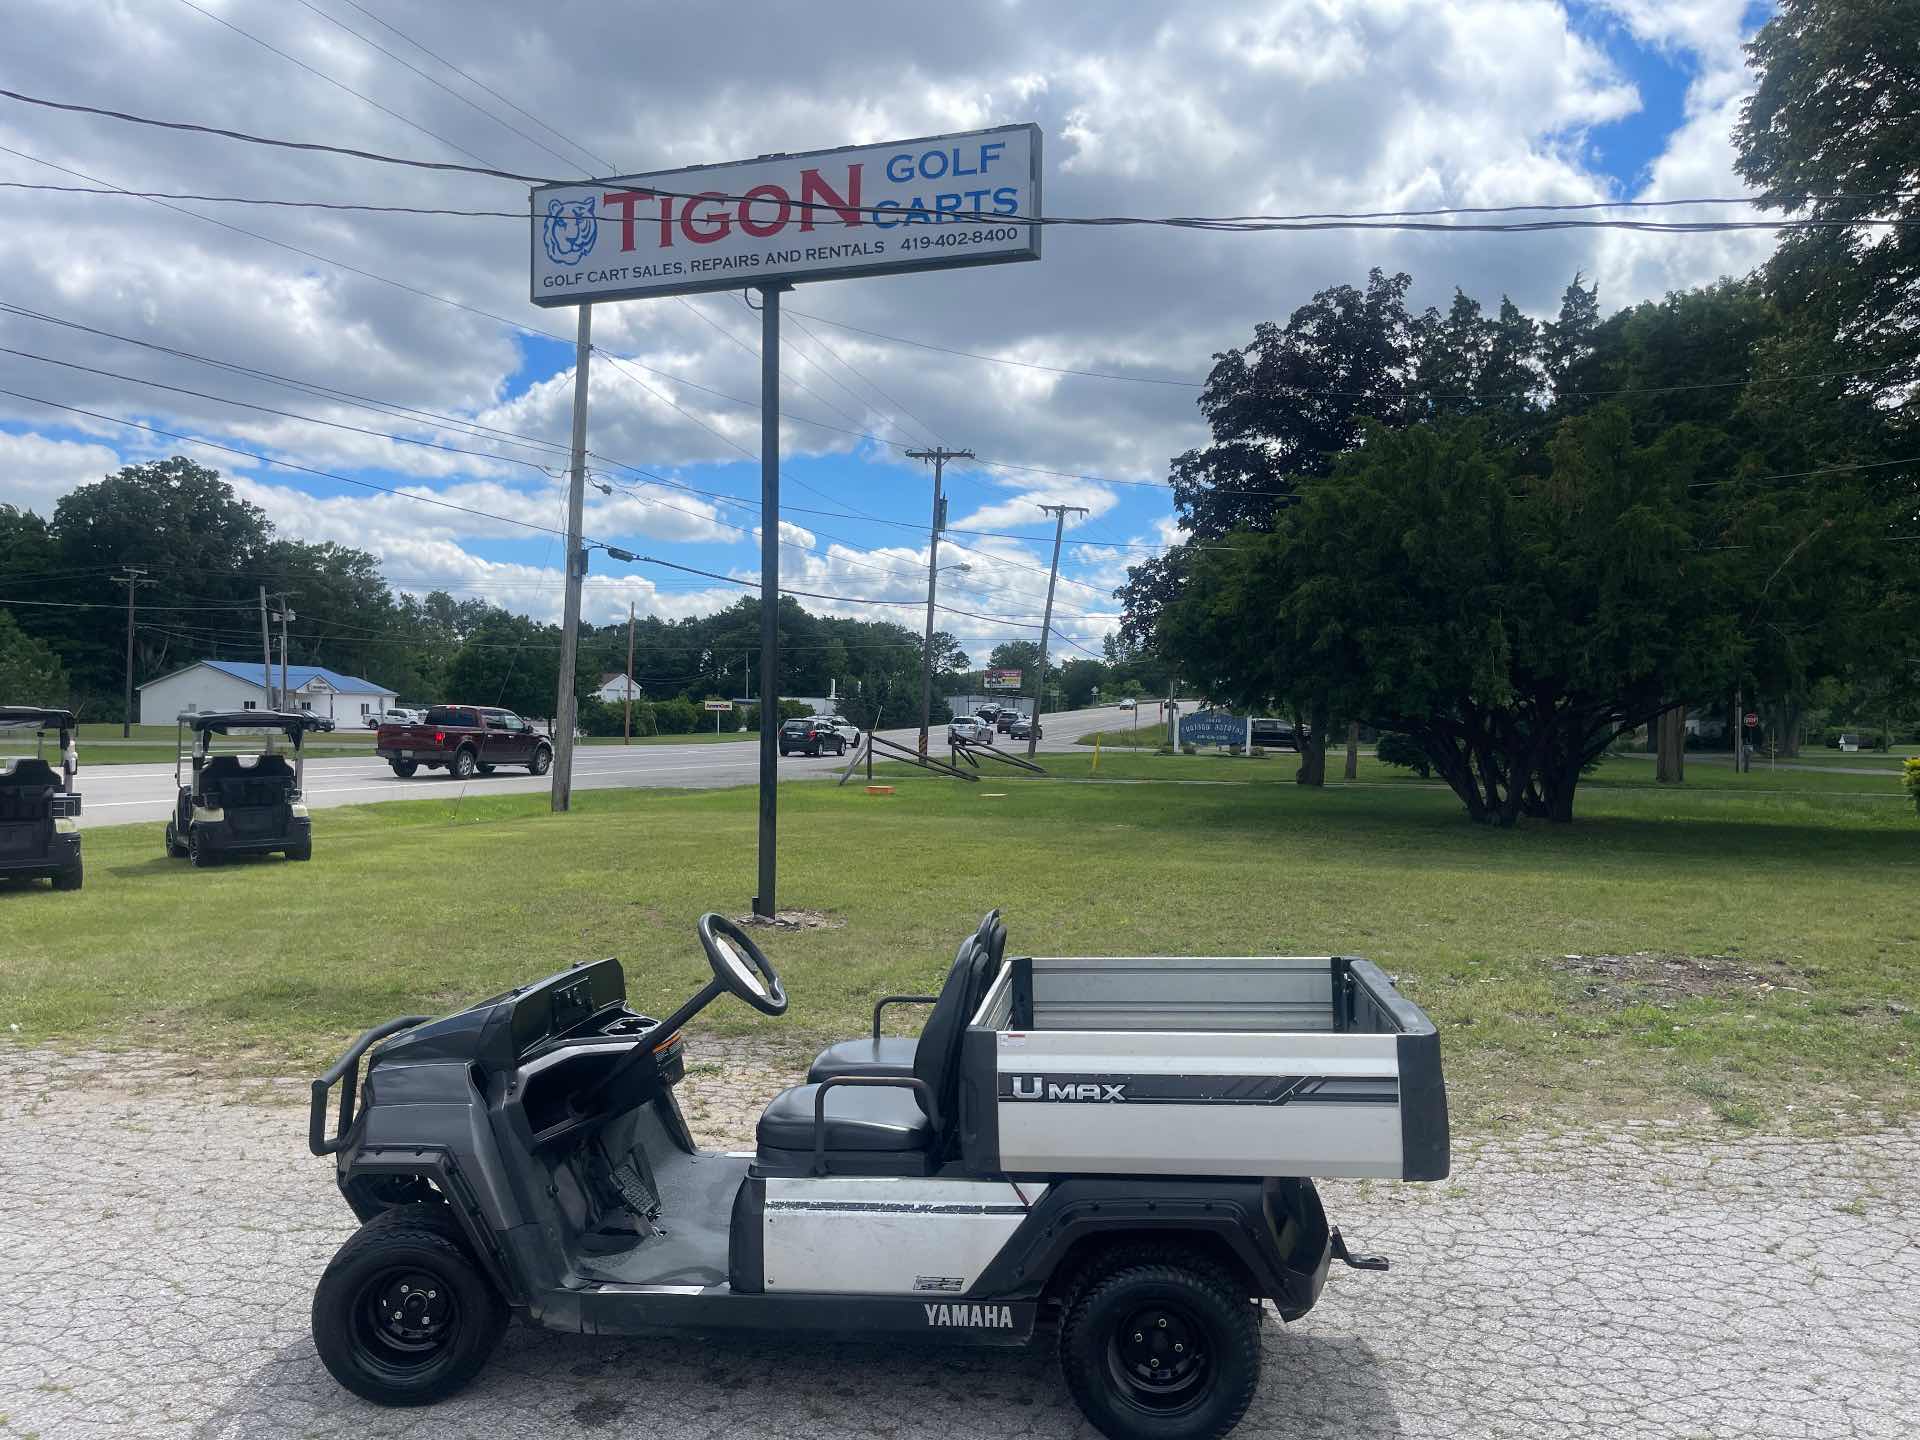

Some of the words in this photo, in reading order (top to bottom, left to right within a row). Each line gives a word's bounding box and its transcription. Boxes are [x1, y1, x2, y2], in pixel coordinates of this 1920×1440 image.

[886, 141, 1005, 183] GOLF
[603, 163, 865, 253] TIGON
[872, 187, 1018, 229] CARTS
[901, 227, 1018, 251] 419-402-8400
[543, 272, 585, 288] GOLF
[588, 267, 629, 283] CART
[633, 261, 687, 279] SALES,
[690, 253, 760, 272] REPAIRS
[765, 248, 801, 265] AND
[806, 240, 885, 261] RENTALS
[924, 1303, 1014, 1328] YAMAHA
